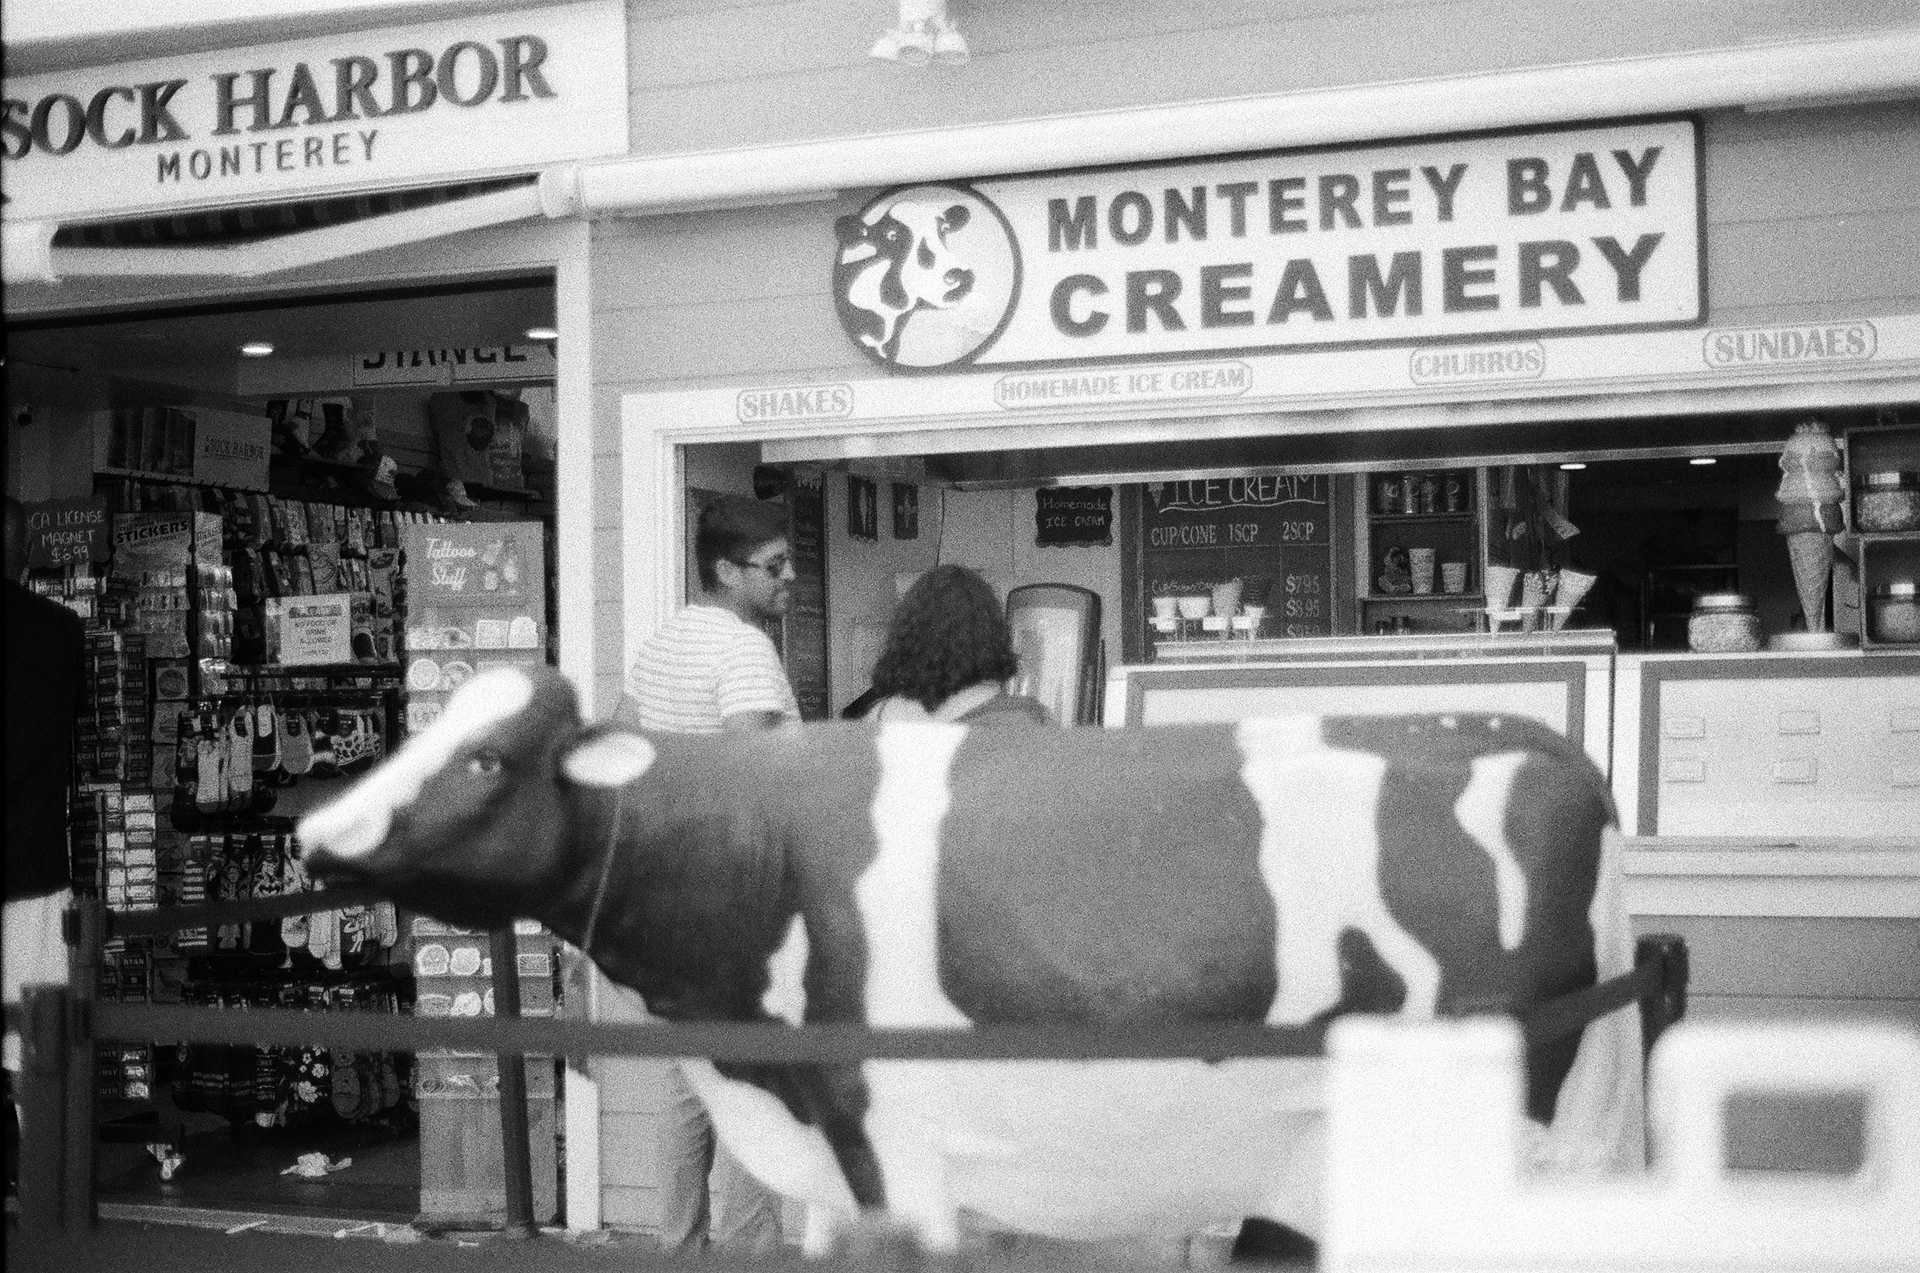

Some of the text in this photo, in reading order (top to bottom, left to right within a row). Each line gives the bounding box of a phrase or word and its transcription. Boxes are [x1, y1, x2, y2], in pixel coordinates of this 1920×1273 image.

[1, 34, 558, 161] SOCK HARBOR
[157, 129, 380, 183] MONTEREY
[1047, 146, 1664, 253] MONTEREY BAY
[1049, 231, 1665, 338] CREAMERY
[1714, 326, 1867, 363] SUNDAES
[1414, 347, 1541, 378] CHURROS
[1000, 367, 1246, 401] HOMEMADE ICE CREAM
[742, 388, 848, 419] SHAKES
[1042, 496, 1108, 511] Homemade
[1228, 475, 1318, 503] CREAM
[29, 512, 51, 530] CA
[56, 510, 105, 526] LICENSE
[116, 520, 188, 544] STICKERS
[1150, 524, 1218, 547] CUP/CONE
[1282, 520, 1315, 541] 2SCP
[41, 529, 96, 548] MAGNET
